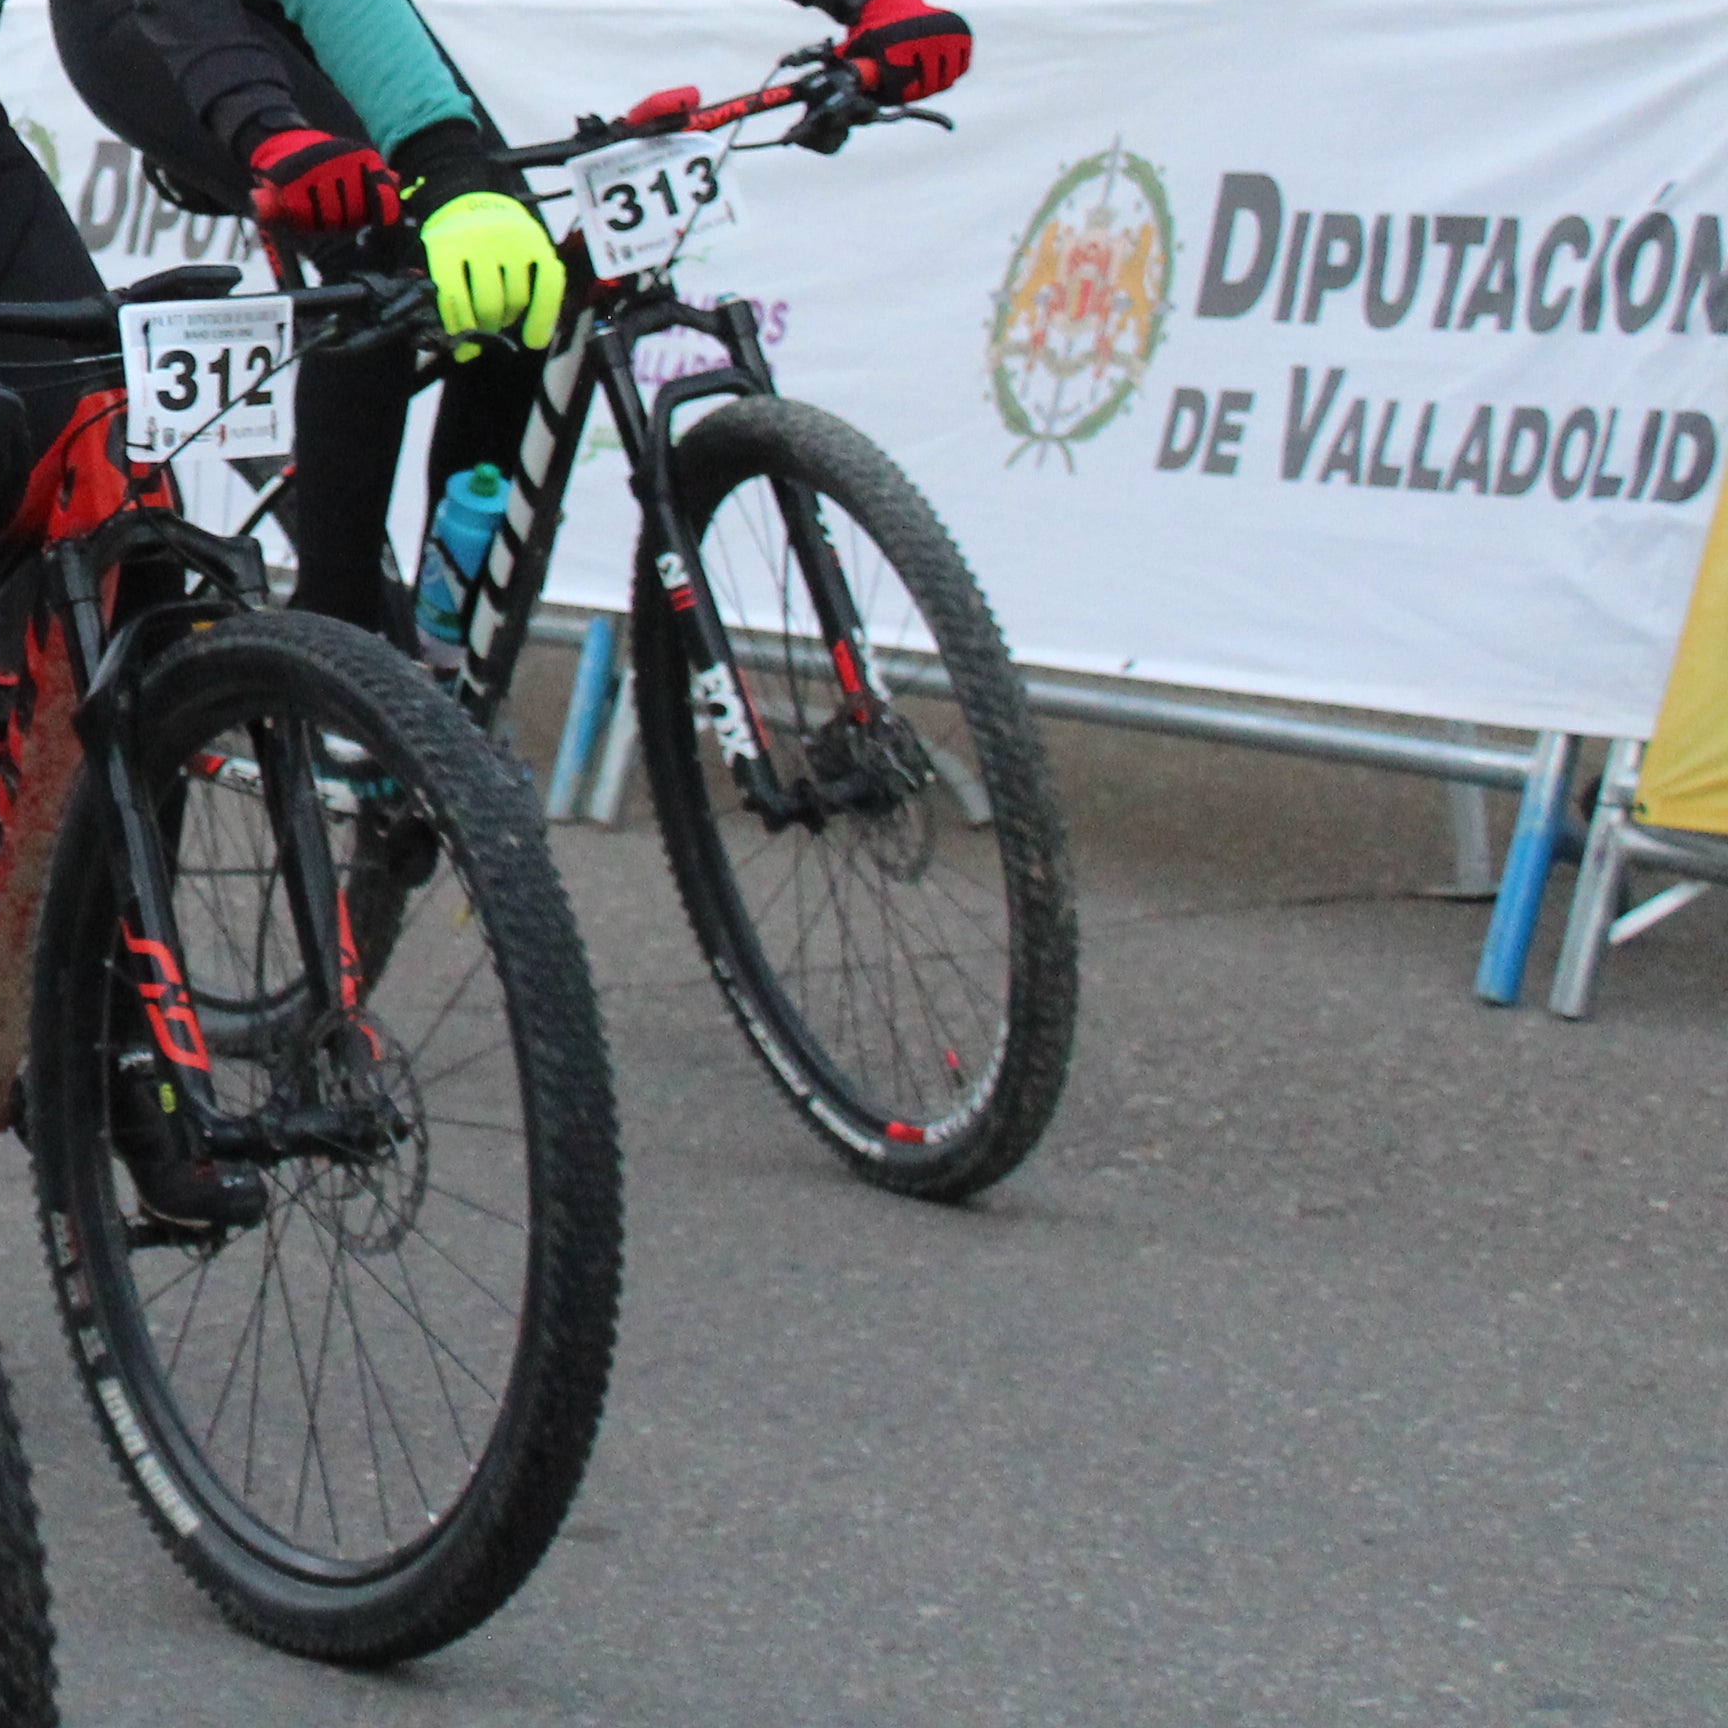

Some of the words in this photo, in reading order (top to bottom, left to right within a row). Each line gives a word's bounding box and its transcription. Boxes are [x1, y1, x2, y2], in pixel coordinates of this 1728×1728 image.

[601, 156, 719, 232] 313
[1194, 170, 1728, 336] DIPUTACIÓN
[155, 344, 274, 413] 312
[1154, 386, 1255, 476] DE
[1277, 364, 1719, 505] VALLADOLID
